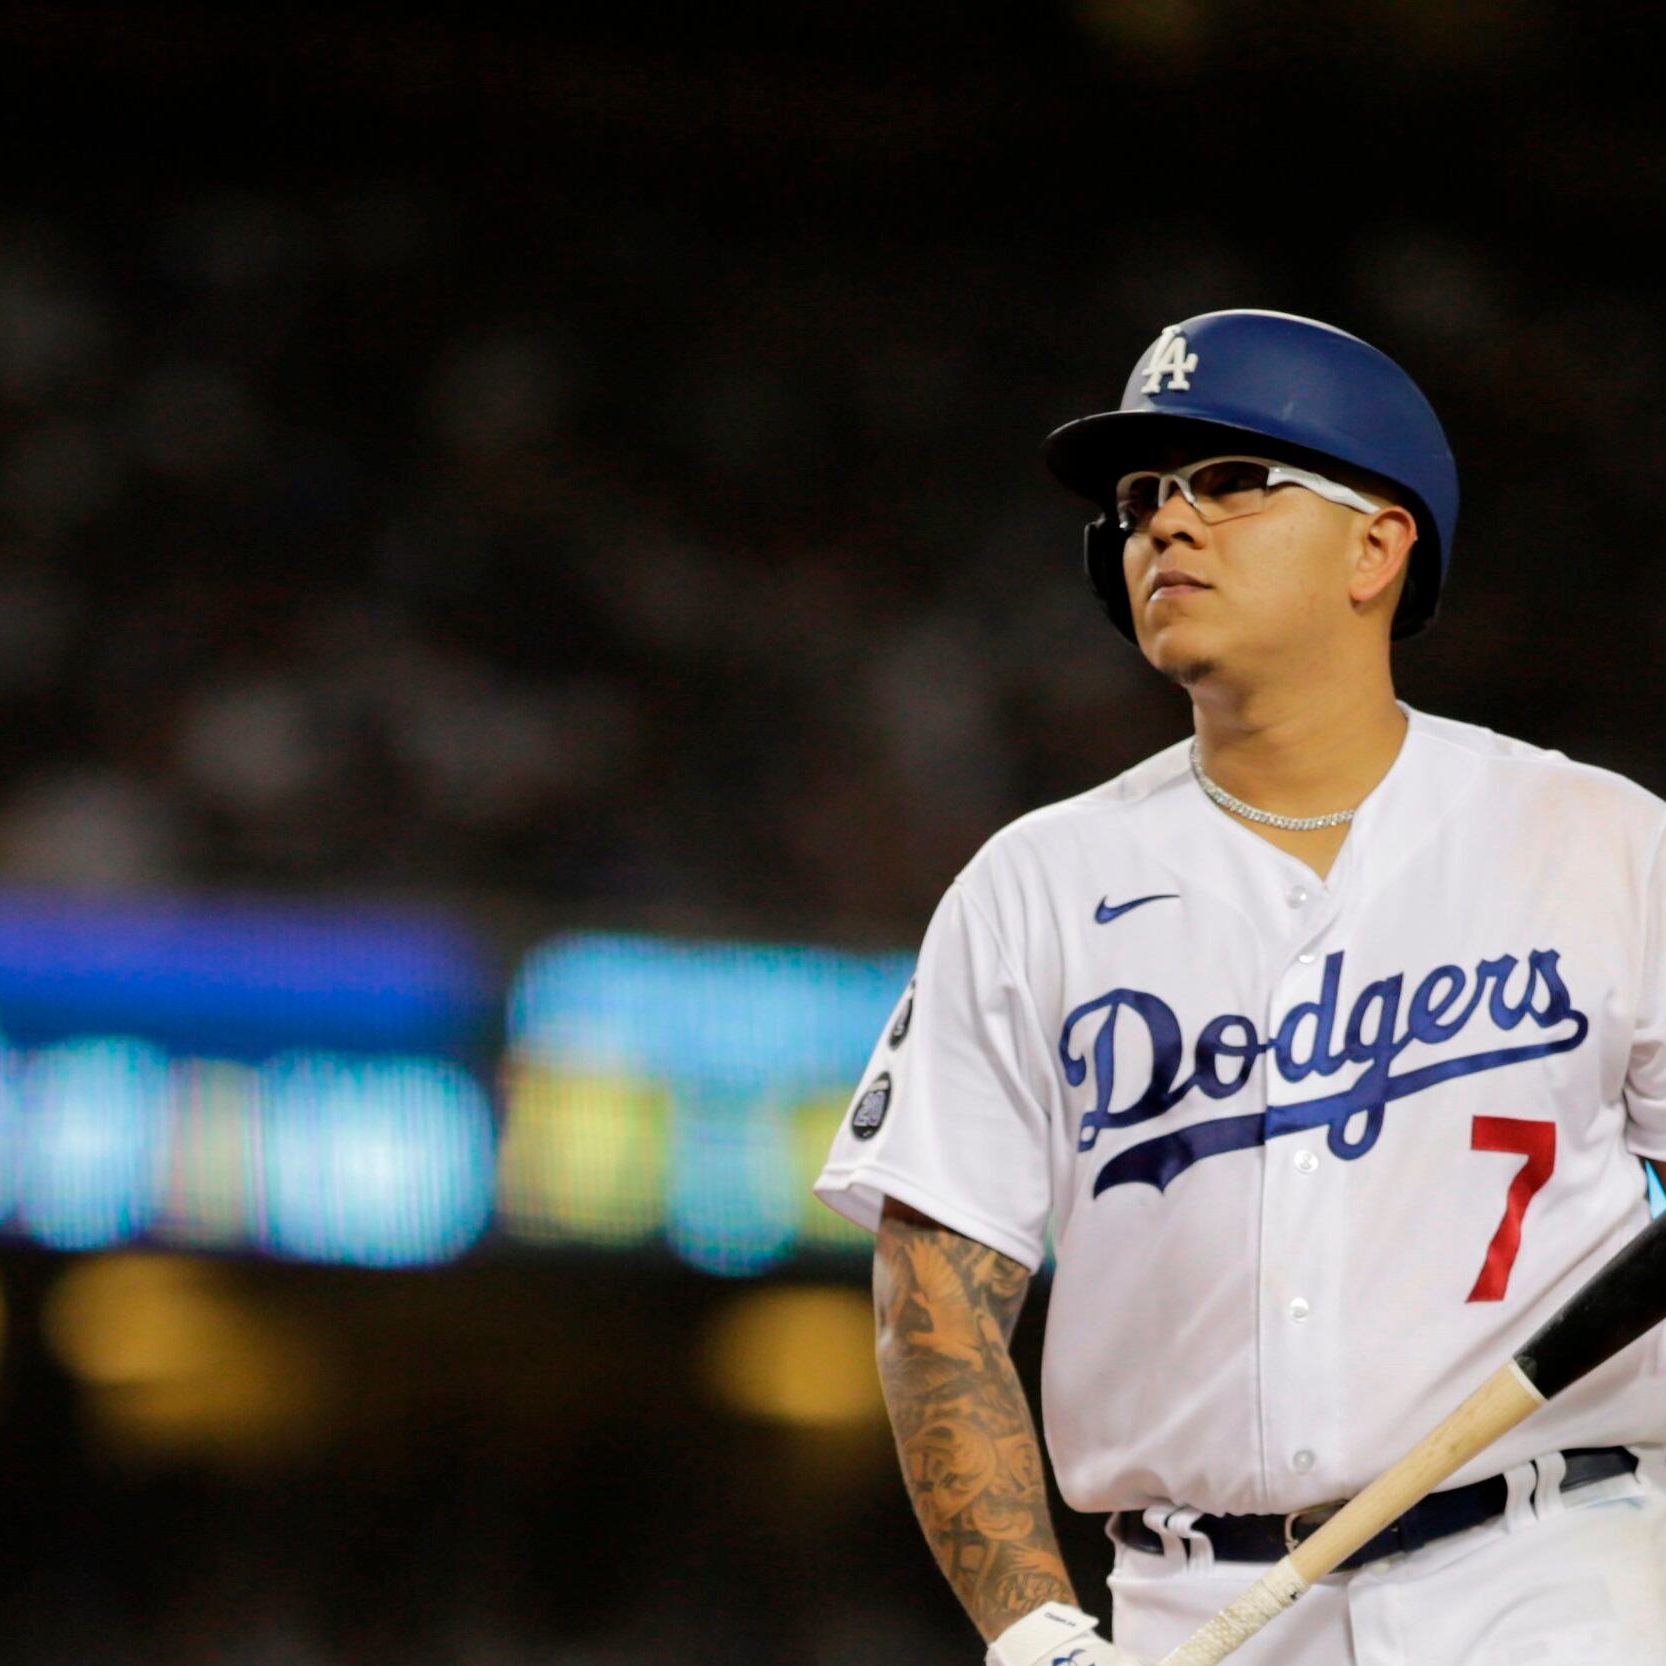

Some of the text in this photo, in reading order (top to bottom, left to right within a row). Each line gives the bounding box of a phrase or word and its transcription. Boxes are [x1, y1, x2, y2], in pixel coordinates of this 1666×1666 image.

[1141, 325, 1199, 394] LA
[1059, 949, 1586, 1164] Dodgers
[1465, 1114, 1558, 1304] 7
